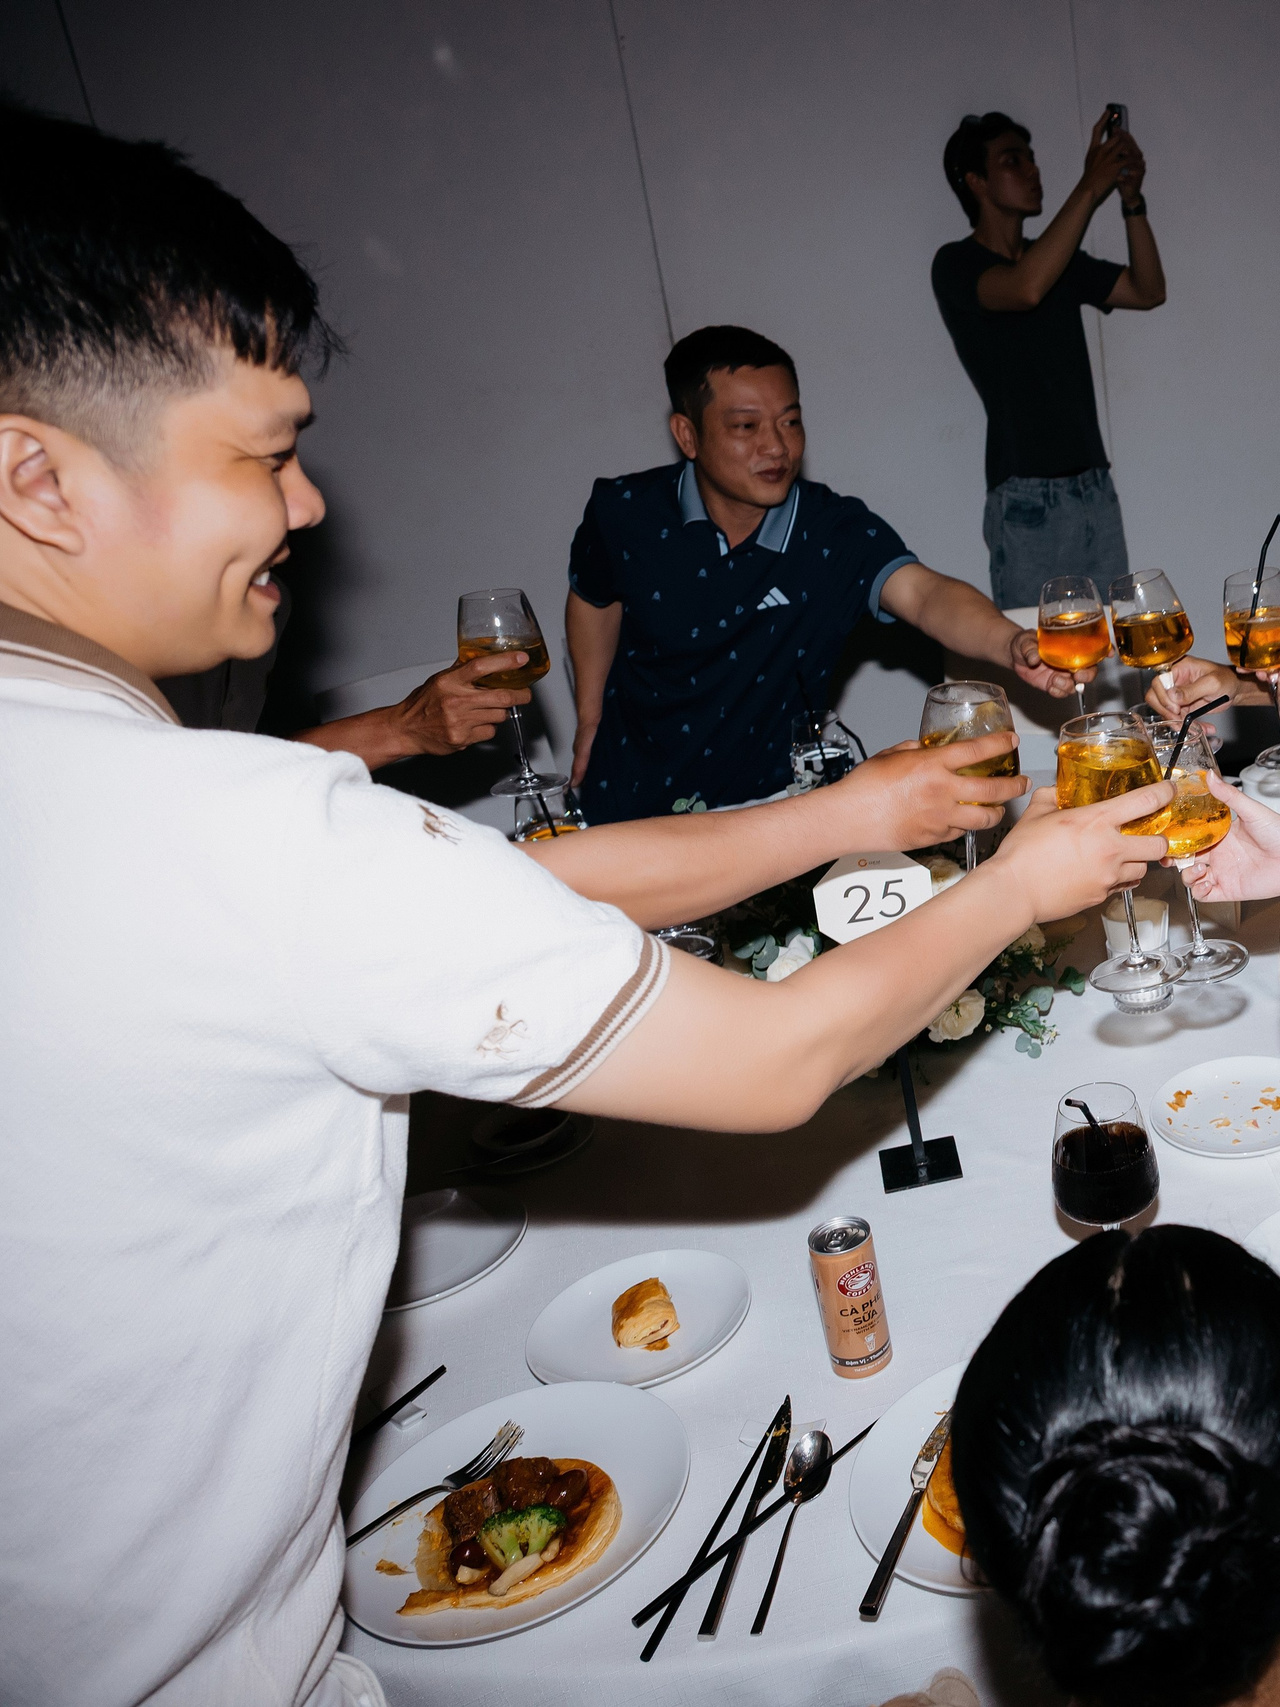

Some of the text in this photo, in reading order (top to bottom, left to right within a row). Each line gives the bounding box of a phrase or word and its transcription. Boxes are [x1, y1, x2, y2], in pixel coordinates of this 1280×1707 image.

[843, 878, 907, 925] 25
[840, 1304, 859, 1317] CÀ
[853, 1309, 878, 1327] SỮA
